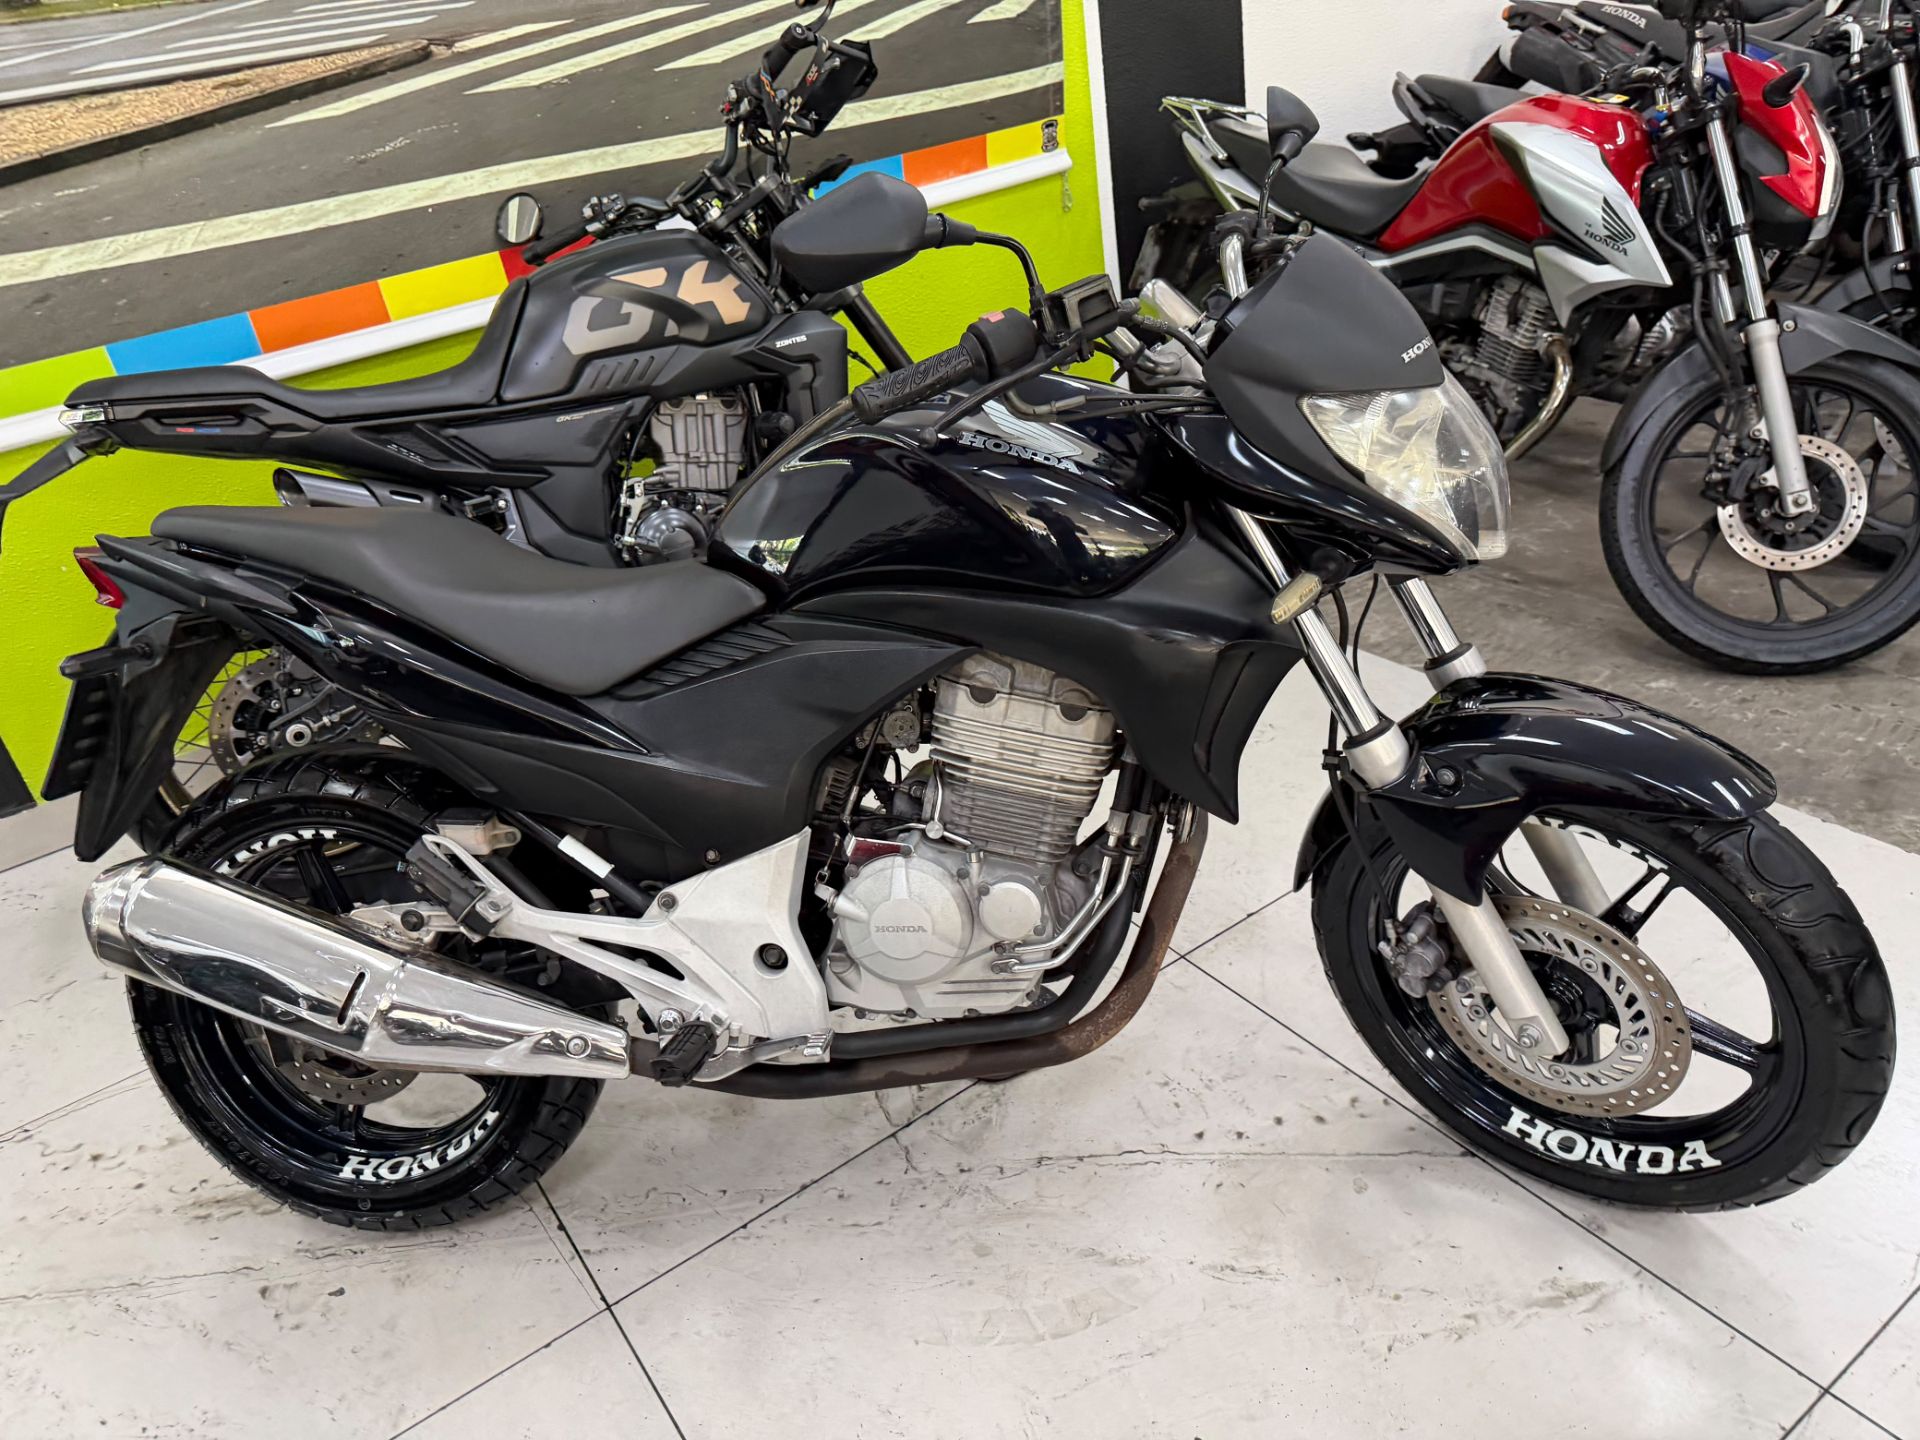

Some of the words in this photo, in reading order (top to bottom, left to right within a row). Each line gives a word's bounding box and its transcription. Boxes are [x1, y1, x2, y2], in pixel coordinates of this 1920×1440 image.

[1600, 5, 1647, 29] HONDA
[1584, 229, 1628, 257] HONDA
[562, 260, 751, 356] GK
[775, 335, 807, 348] ZONTES
[1400, 336, 1433, 363] HON
[958, 431, 1084, 476] HONDA
[874, 925, 928, 933] HONDA
[1501, 1106, 1722, 1175] HONDA
